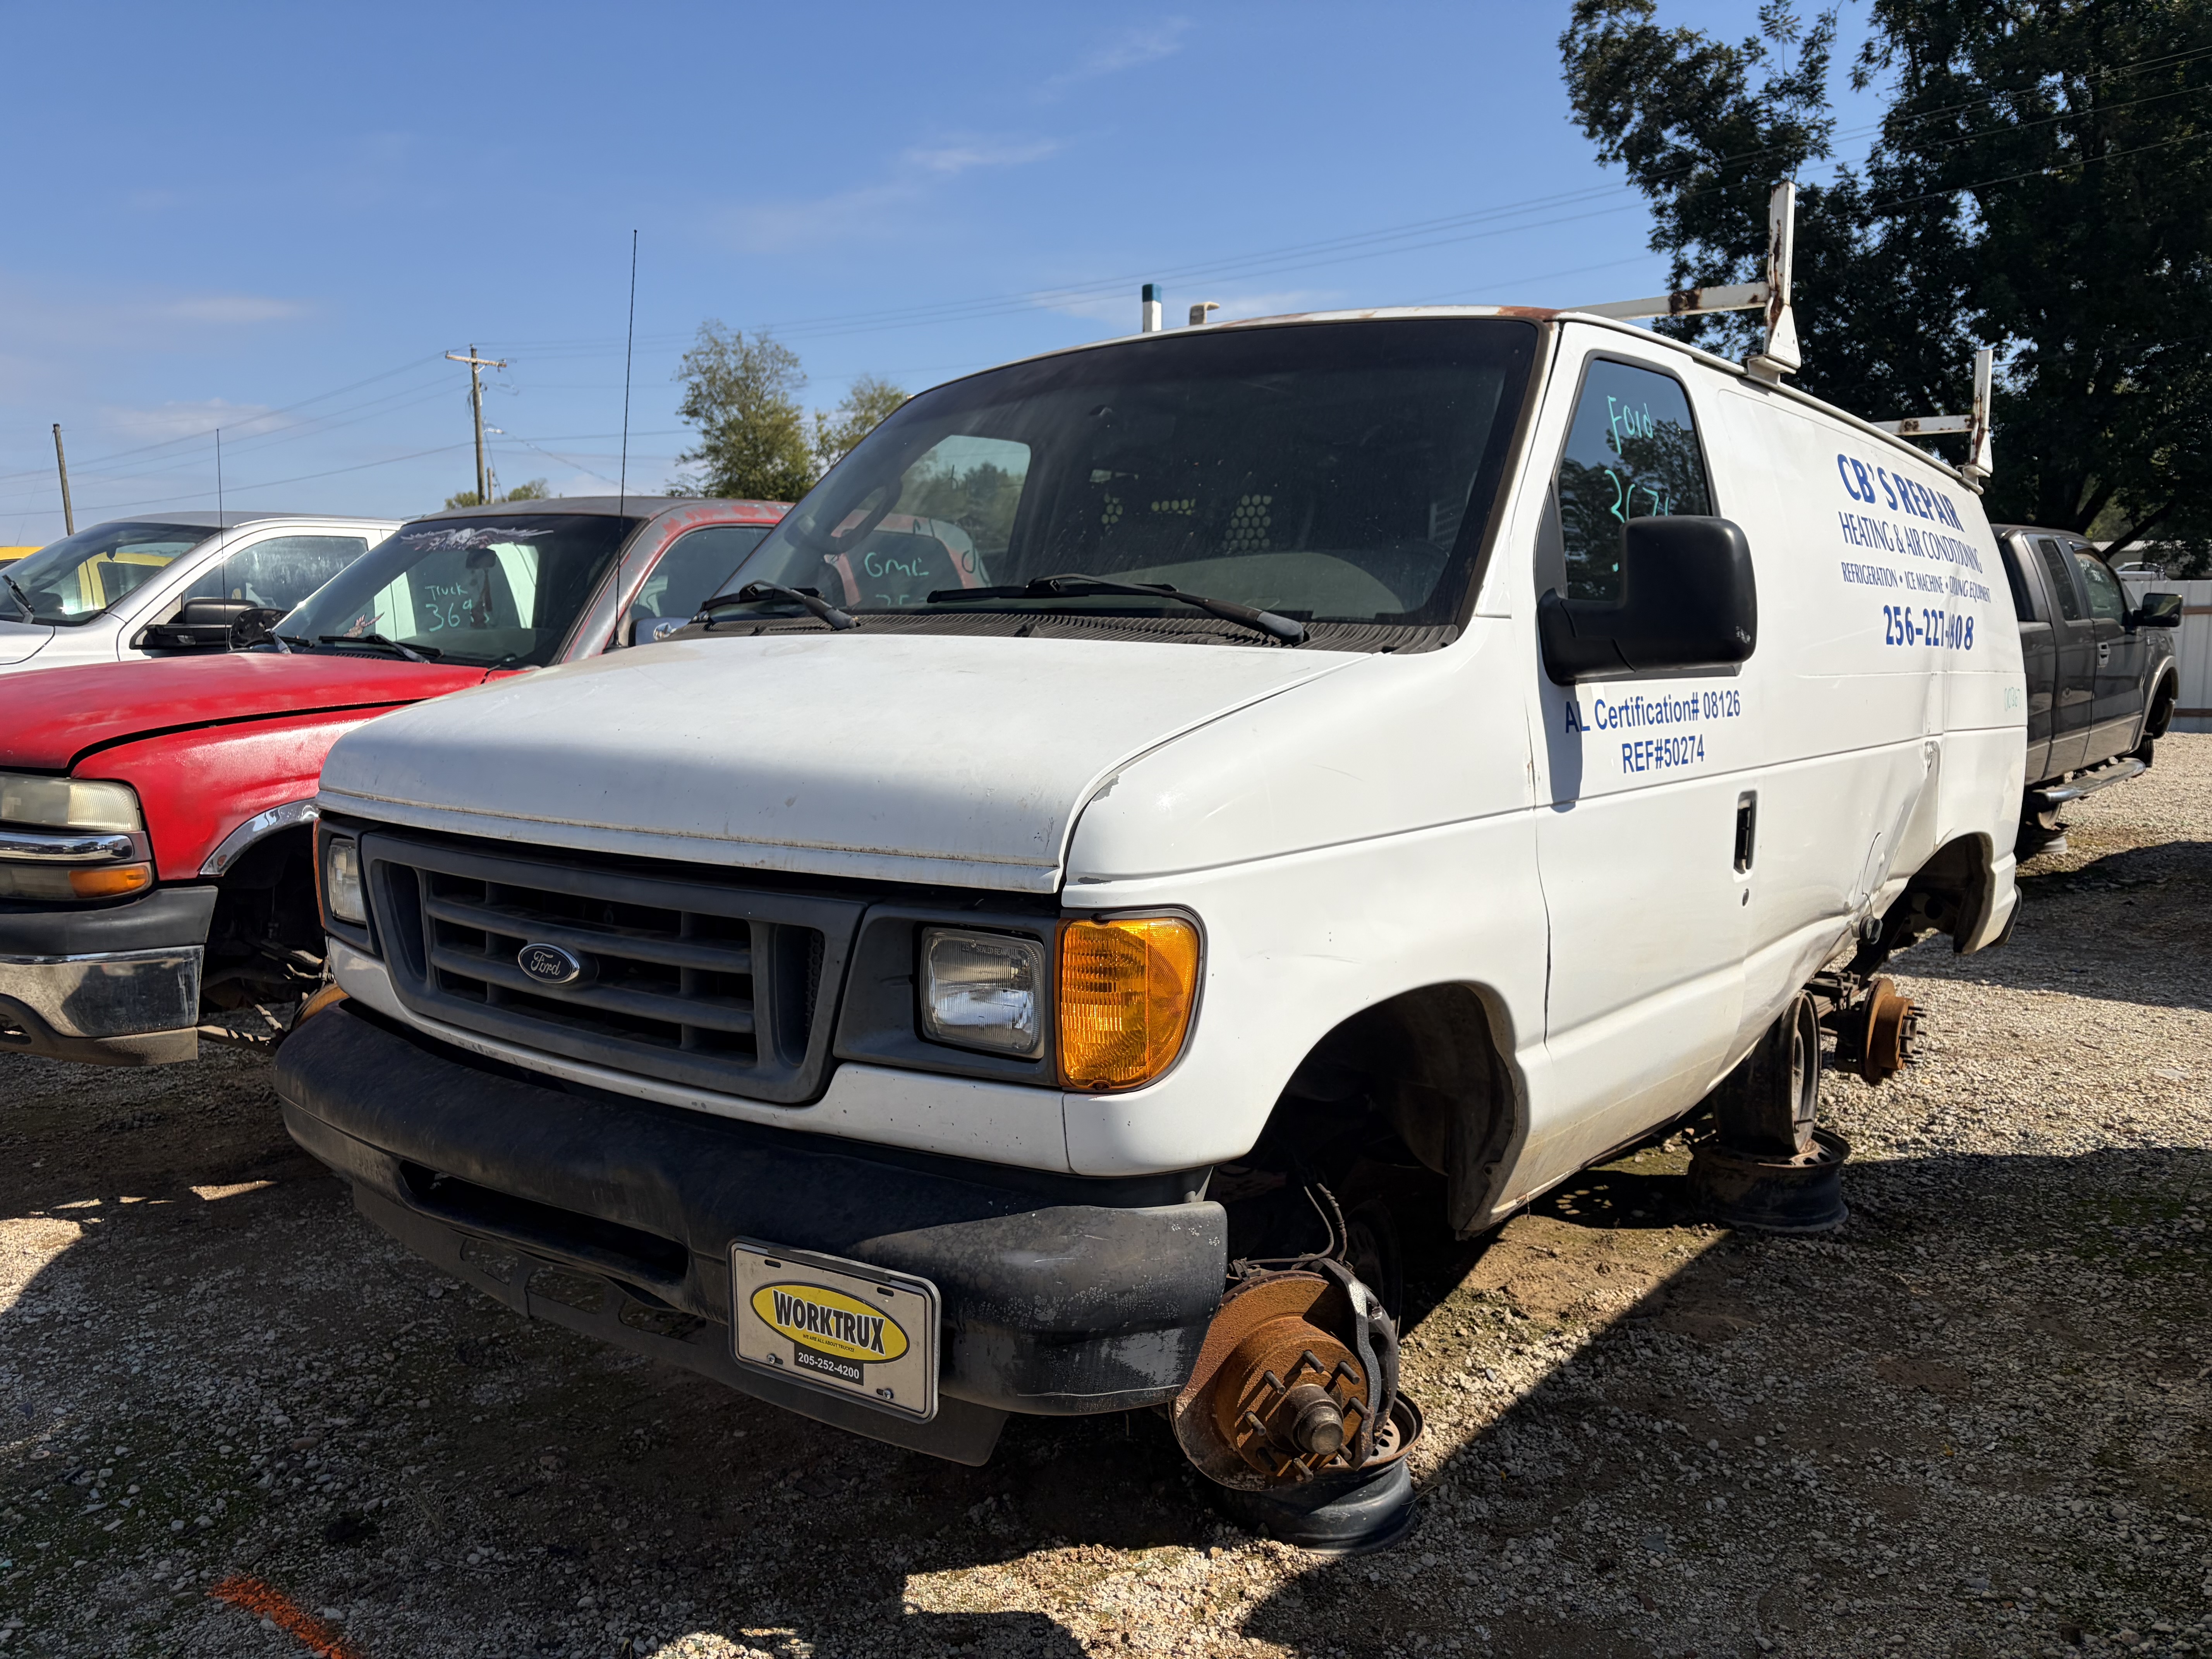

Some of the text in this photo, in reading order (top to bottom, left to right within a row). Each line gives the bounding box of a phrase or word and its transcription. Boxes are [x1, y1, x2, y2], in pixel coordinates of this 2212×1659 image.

[1891, 472, 1965, 533] REPAIR
[1838, 511, 1983, 574] HEATING & AIR CONDITIONING
[1841, 562, 1898, 588] REFRIGERATION
[1905, 570, 1916, 590] ICE
[1915, 572, 1944, 594] MACHINE
[1565, 690, 1741, 733] AL Certification# 08126
[1622, 734, 1704, 774] REF#50274
[531, 951, 561, 975] Ford
[772, 1289, 886, 1356] WORKTRUX
[798, 1352, 859, 1379] 205-252-4200
